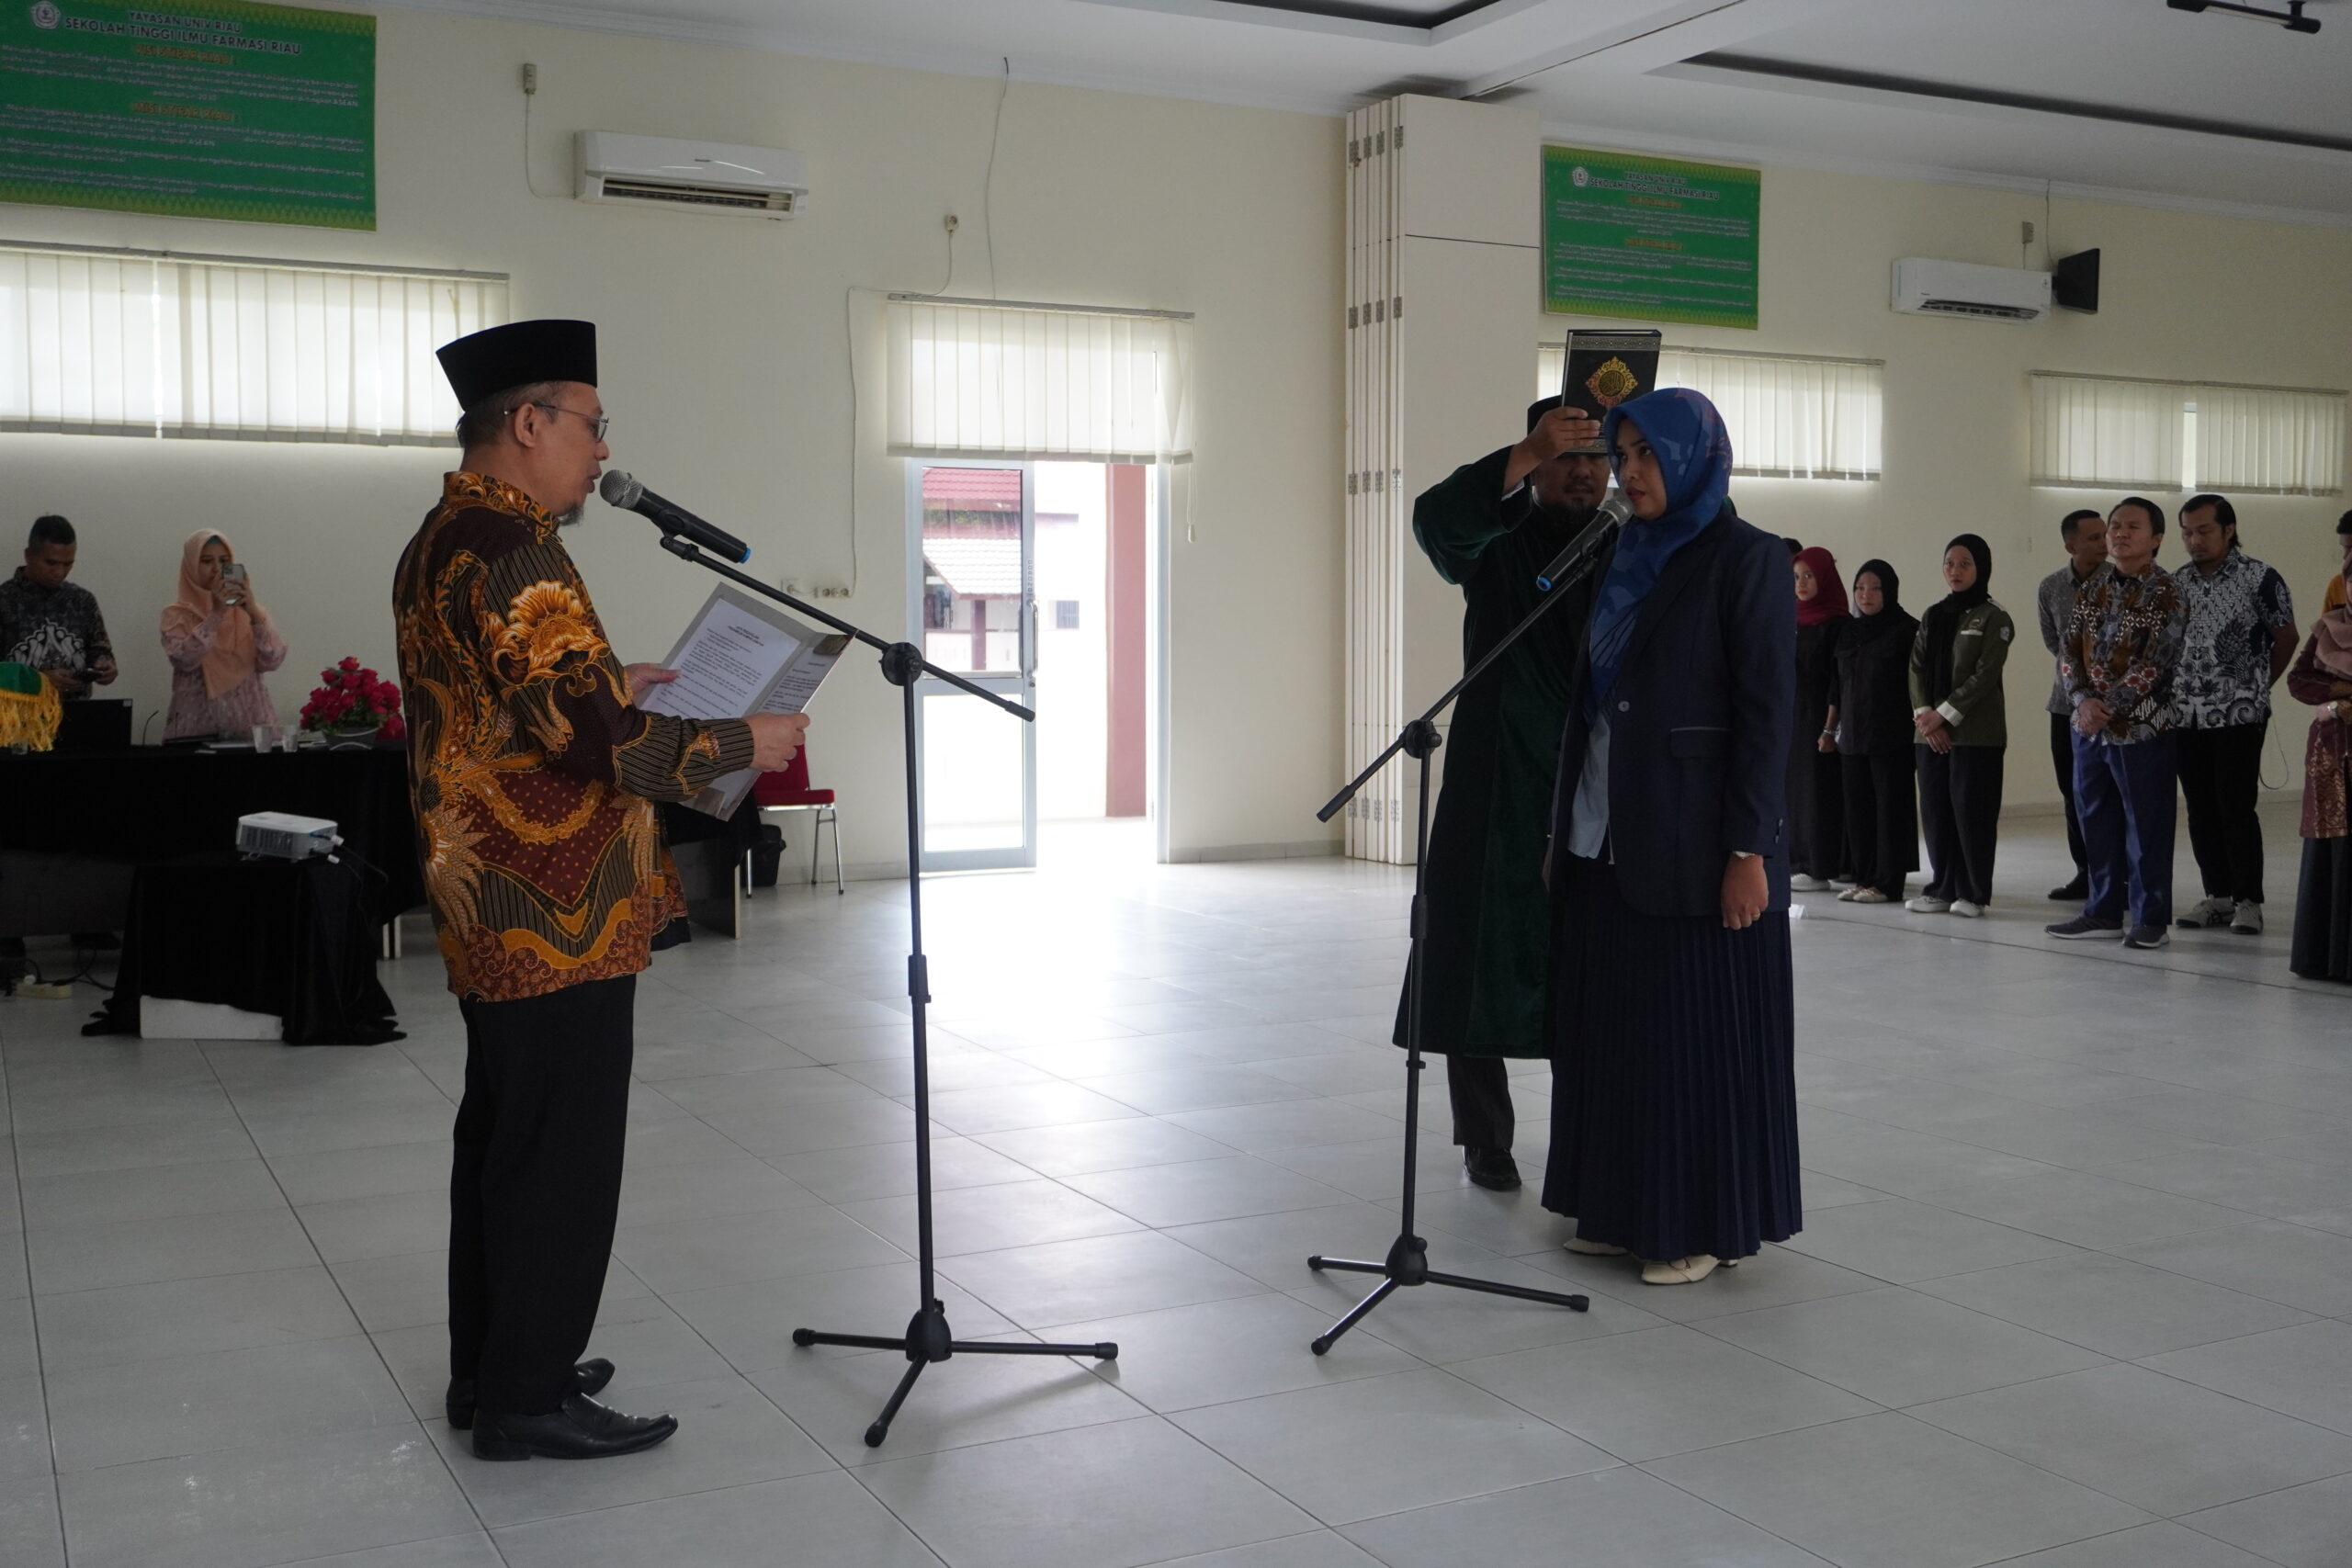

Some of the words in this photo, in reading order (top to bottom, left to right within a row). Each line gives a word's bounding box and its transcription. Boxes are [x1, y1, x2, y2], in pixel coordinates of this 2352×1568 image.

[130, 11, 180, 26] YAYASAN
[184, 17, 210, 29] UNIV
[215, 21, 240, 33] RIAU
[65, 17, 125, 34] SEKOLAH
[130, 25, 174, 39] TINGGI
[177, 30, 208, 44] ILMU
[212, 35, 267, 51] FARMASI
[272, 42, 301, 54] RIAU
[1589, 177, 1623, 189] SEKOLAH
[1624, 181, 1648, 192] TINGGI
[1649, 184, 1668, 195] ILMU
[1669, 186, 1701, 197] FARMASI
[1702, 189, 1719, 200] RIAU
